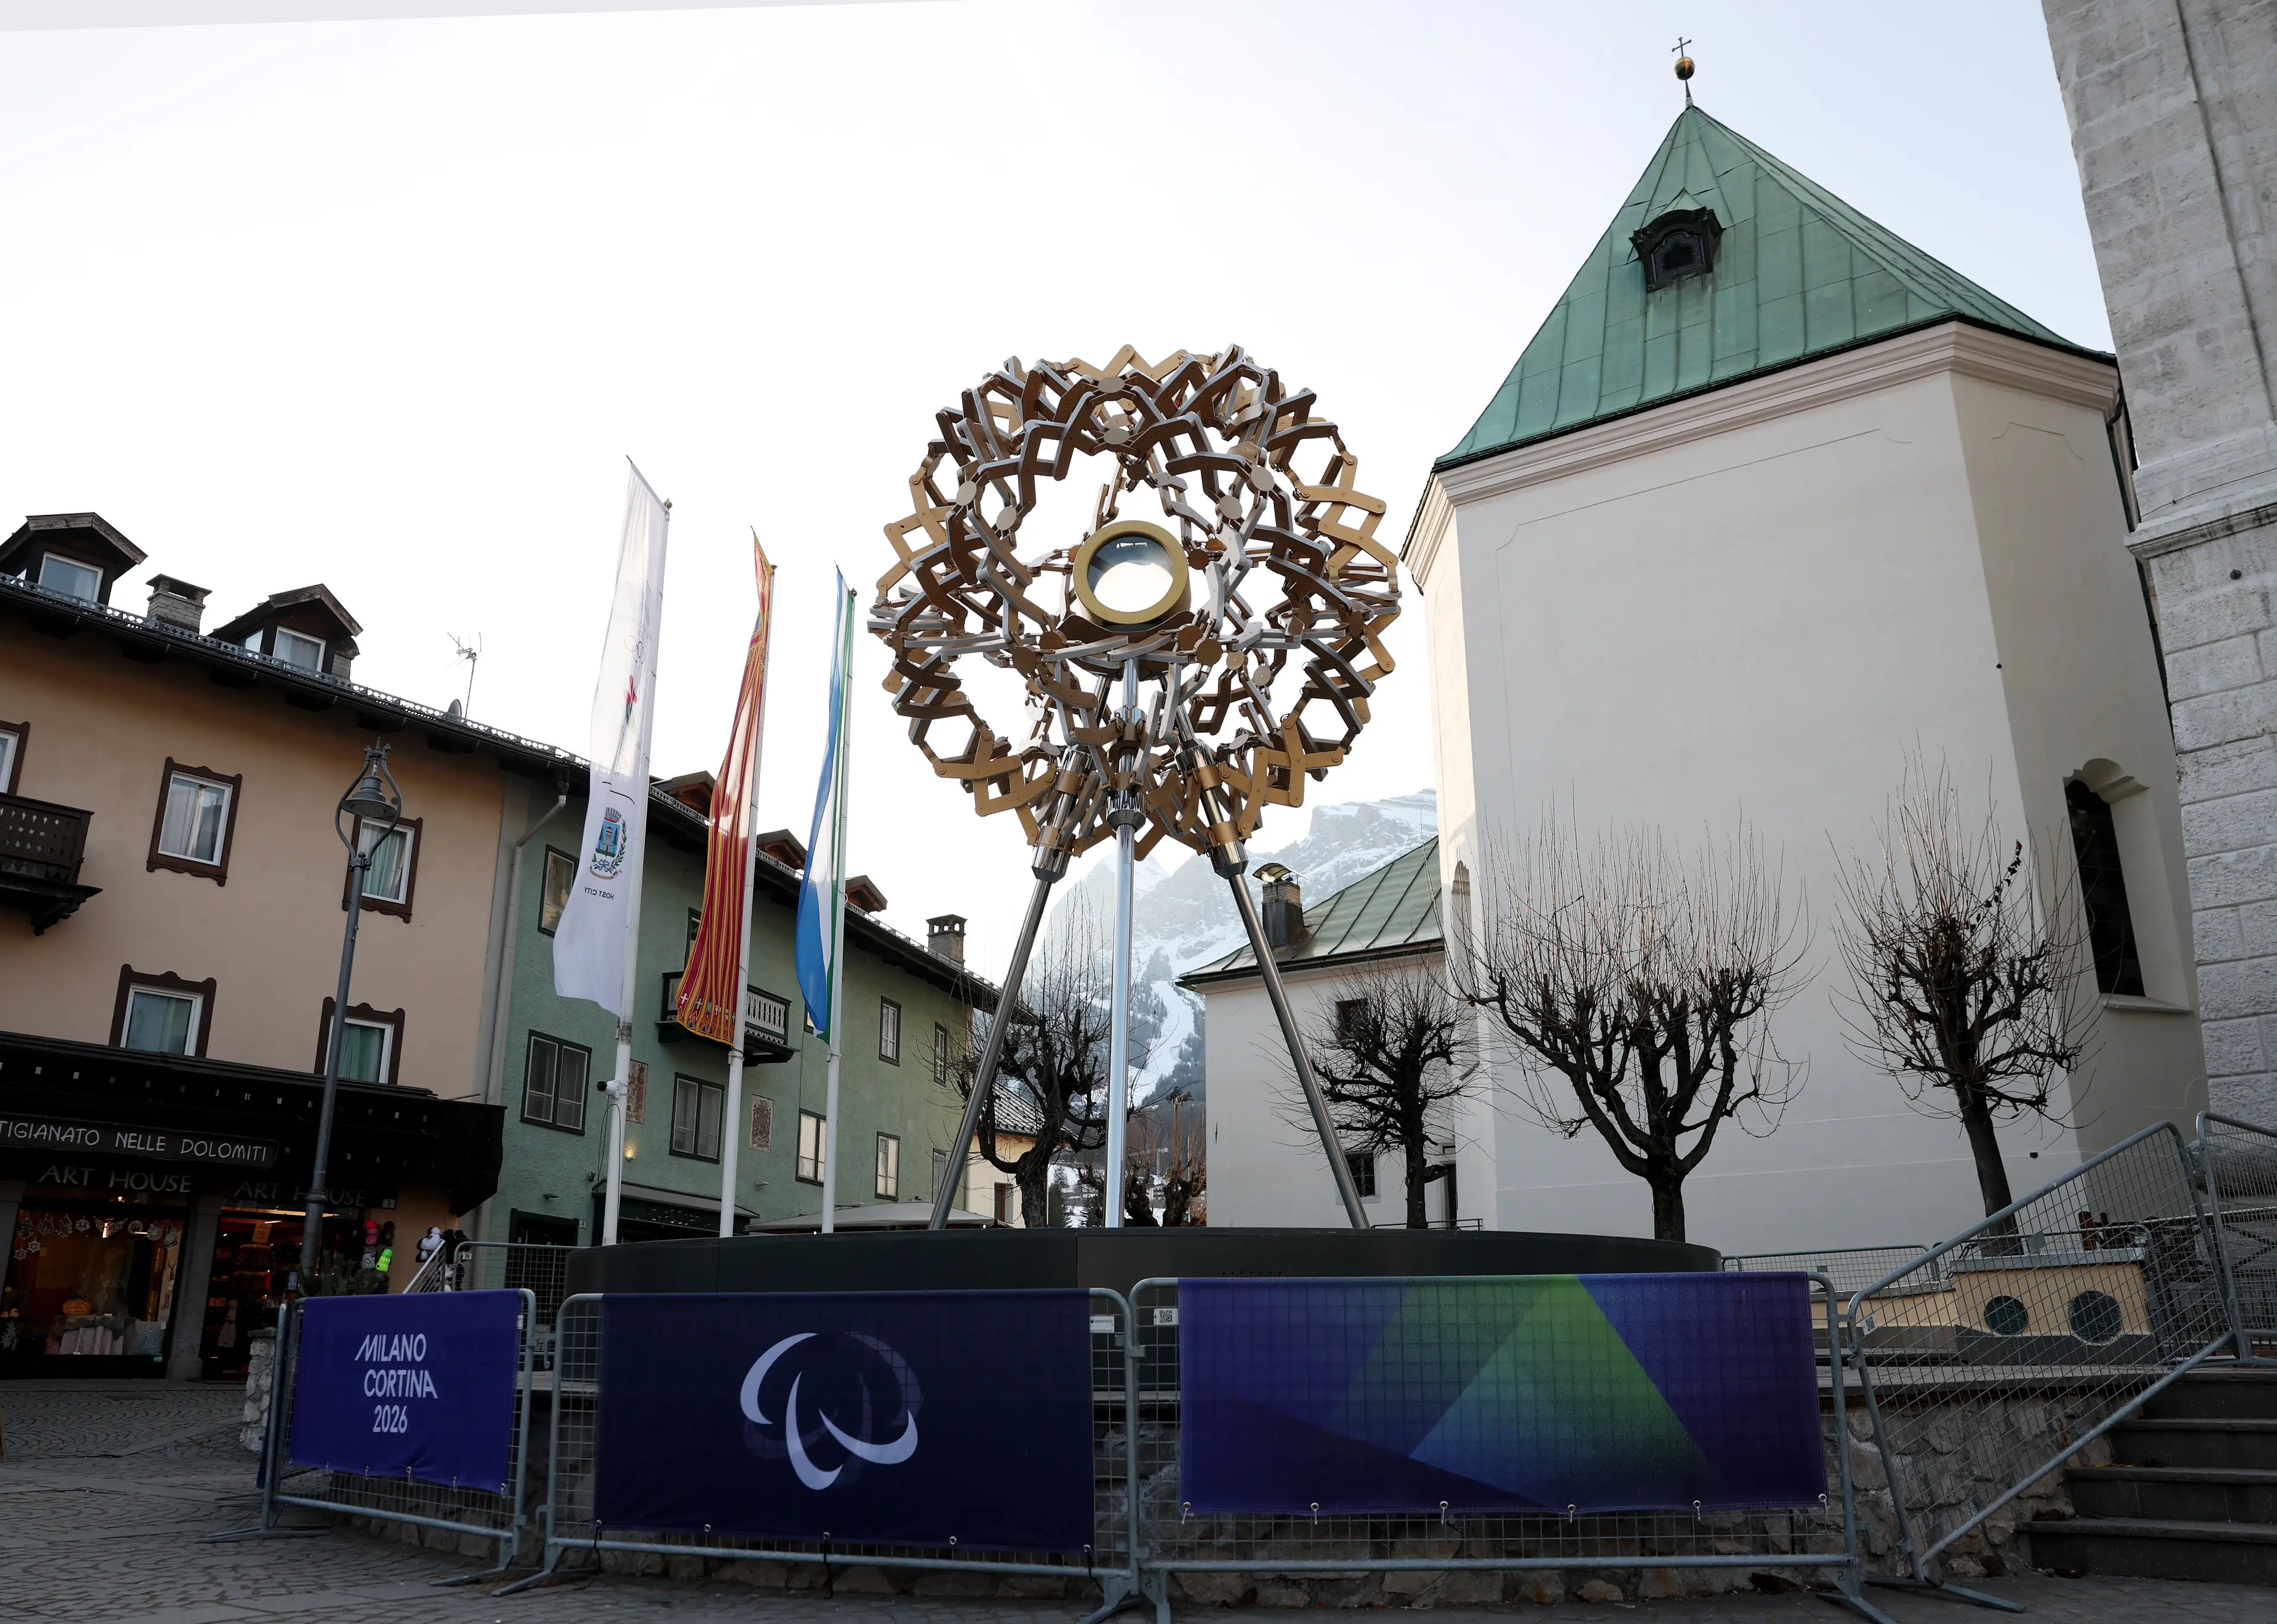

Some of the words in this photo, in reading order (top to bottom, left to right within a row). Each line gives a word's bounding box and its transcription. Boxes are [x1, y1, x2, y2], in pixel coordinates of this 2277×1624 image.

[0, 1120, 100, 1146] TIGIANATO
[115, 1132, 167, 1151] NELLE
[180, 1138, 267, 1162] DOLOMITI
[37, 1164, 96, 1186] ART
[109, 1170, 193, 1194] HOUSE
[233, 1179, 283, 1200] ART
[354, 1333, 427, 1362] MILANO
[364, 1369, 438, 1399] CORTINA
[372, 1405, 408, 1434] 2026
